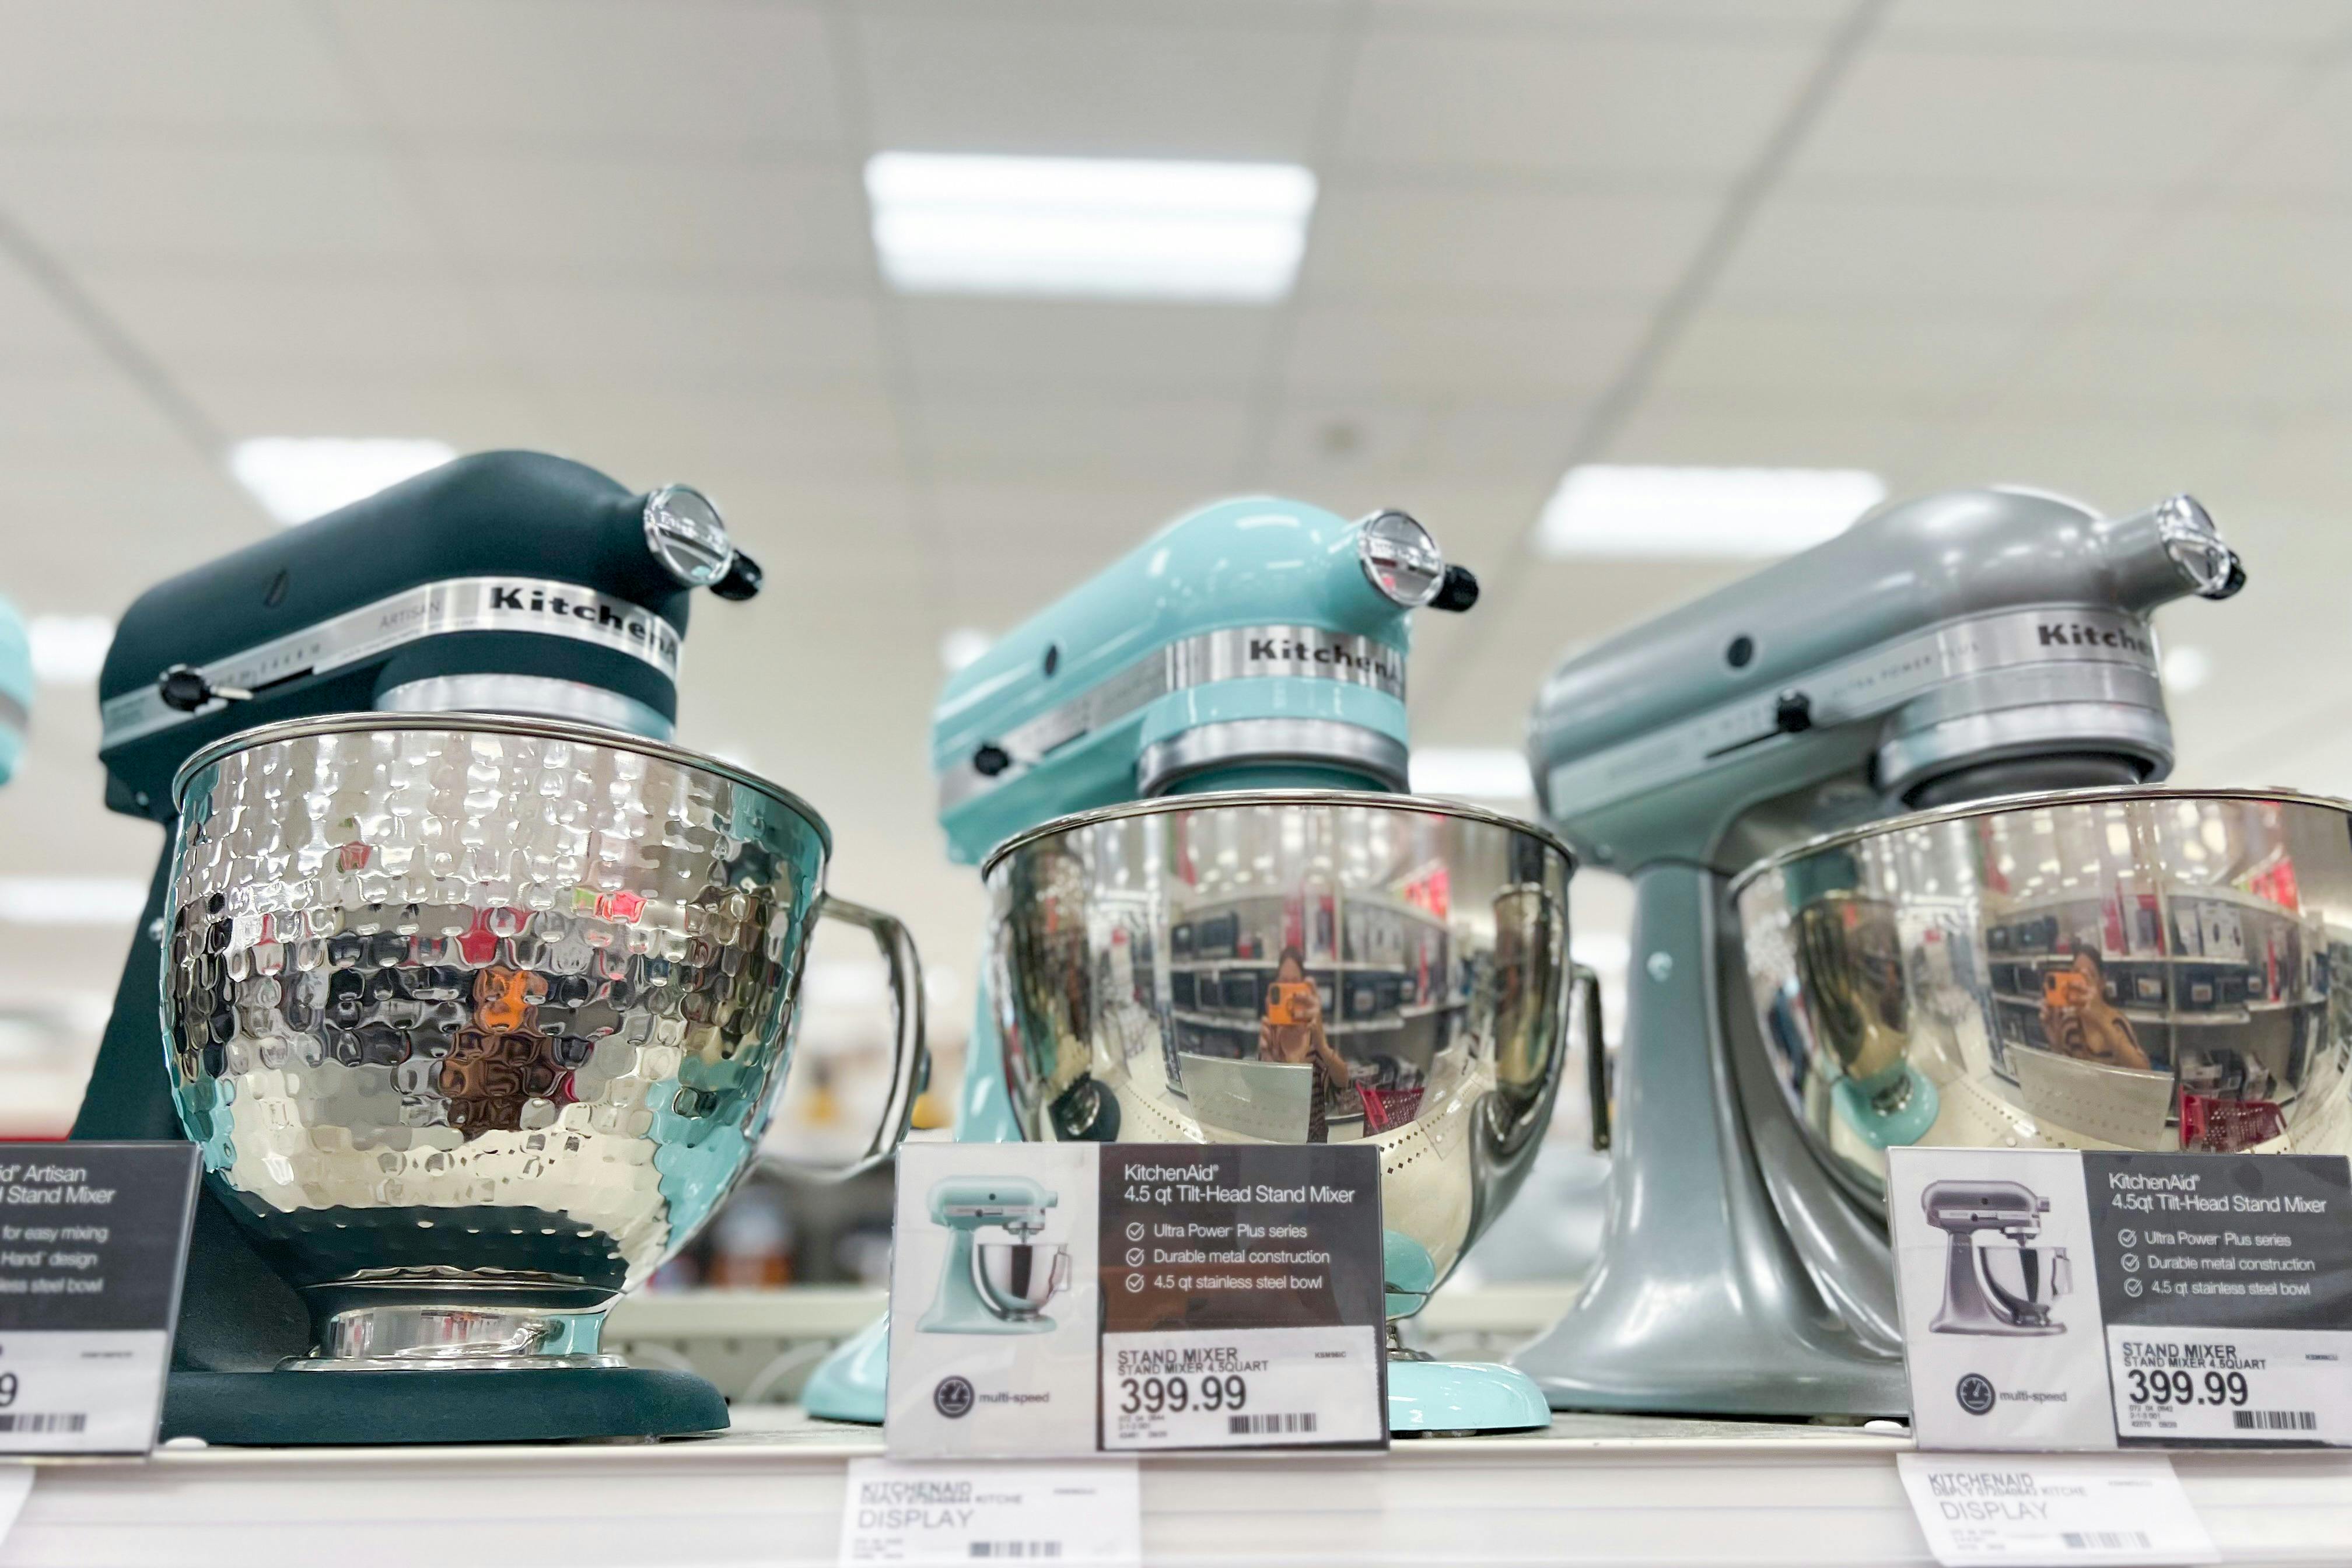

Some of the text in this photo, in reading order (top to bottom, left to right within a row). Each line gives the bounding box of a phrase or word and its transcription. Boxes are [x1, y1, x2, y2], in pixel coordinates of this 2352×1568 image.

[23, 1164, 86, 1182] Artisan
[7, 1185, 61, 1203] Stand
[66, 1186, 116, 1203] Mixer
[1124, 1185, 1354, 1205] 4.5 qt Tilt-Head Stand Mixer
[2112, 1194, 2327, 1213] 4.5qt Tilt-Head Stand Mixer
[24, 1227, 58, 1243] easy
[61, 1226, 109, 1243] mixing
[1154, 1223, 1184, 1238] Ultra
[1237, 1223, 1265, 1238] Plus
[1269, 1224, 1307, 1238] series
[2144, 1230, 2175, 1245] Ultra
[2224, 1232, 2252, 1246] Plus
[2255, 1234, 2291, 1247] series
[49, 1251, 98, 1269] design
[1154, 1249, 1329, 1264] Durable metal construction
[2147, 1255, 2316, 1271] Durable metal construction
[1154, 1275, 1322, 1292] 4.5 qt stainless steel bowl
[2151, 1280, 2311, 1297] 4.5 qt stainless steel bowl
[1118, 1347, 1238, 1365] STAND MIXER
[2123, 1342, 2237, 1360] STAND MIXER
[1118, 1360, 1269, 1376] STAND MIXER 4.5QUART
[2124, 1356, 2165, 1367] STAND
[2168, 1357, 2206, 1368] MIXER
[1121, 1374, 1247, 1413] 399.99
[2128, 1369, 2248, 1406] 399.99
[979, 1392, 1049, 1406] multi-speed
[2000, 1390, 2067, 1404] multi-speed
[1928, 1473, 2035, 1489] KITCHENAID
[858, 1509, 975, 1529] DISPLAY
[1939, 1501, 2050, 1521] DISPLAY
